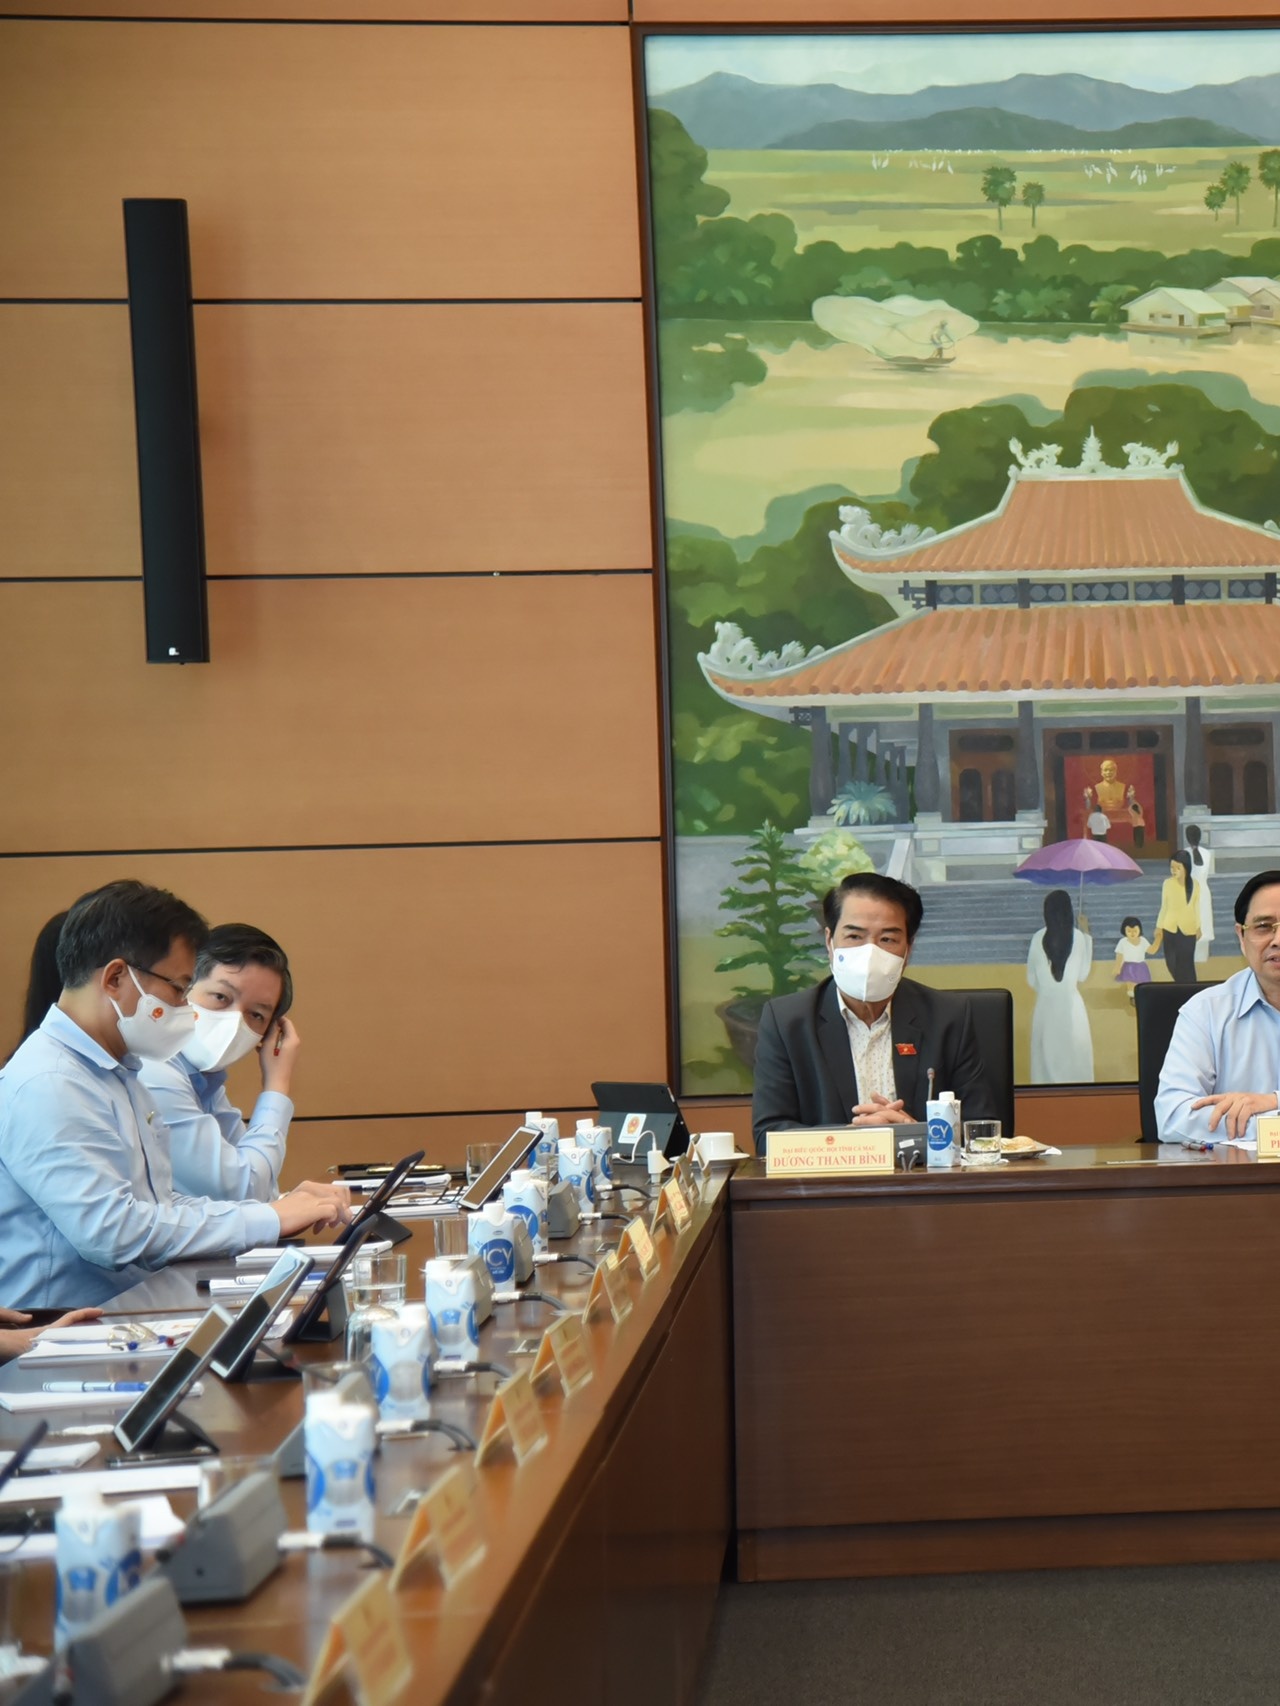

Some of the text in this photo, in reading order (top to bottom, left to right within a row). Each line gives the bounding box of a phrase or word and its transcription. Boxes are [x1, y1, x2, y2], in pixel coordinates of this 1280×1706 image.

[928, 1124, 949, 1139] CY
[773, 1152, 886, 1168] DƯƠNG THANH BÌNH
[483, 1247, 513, 1267] ICY
